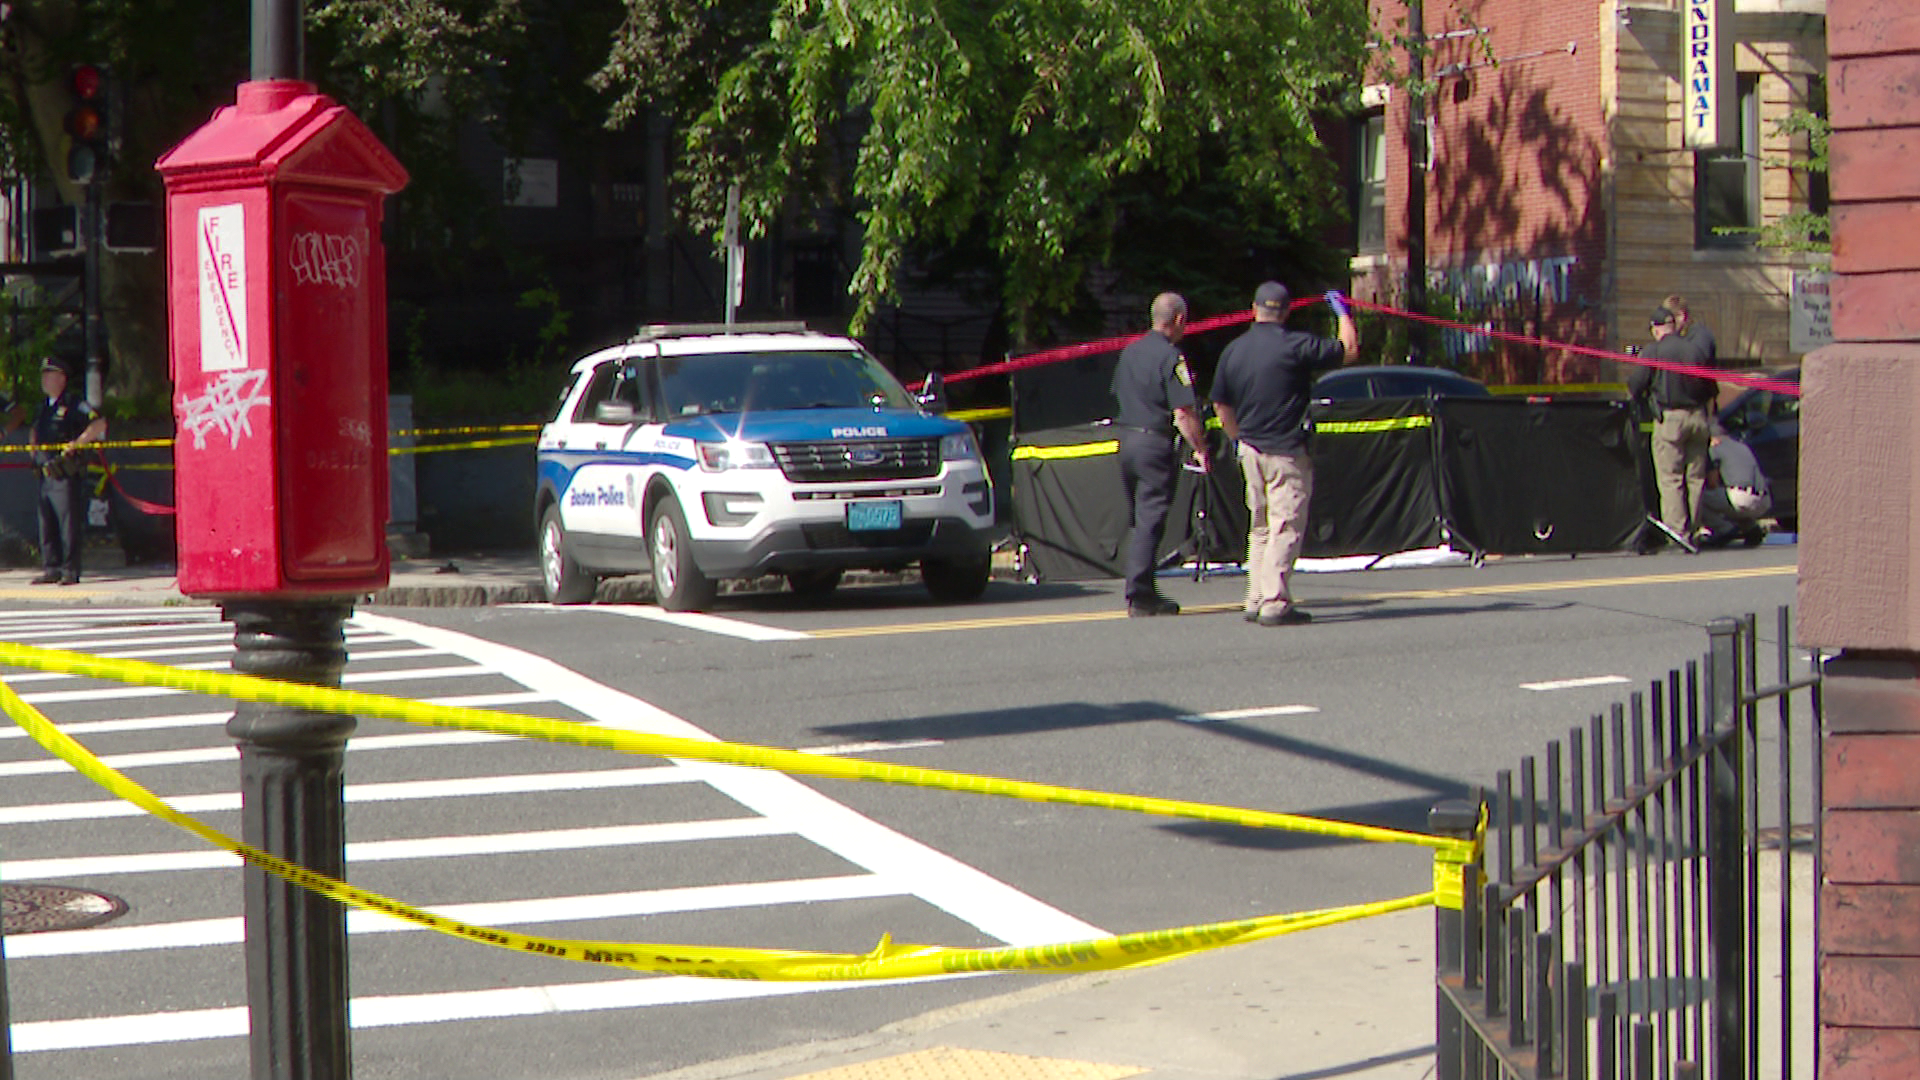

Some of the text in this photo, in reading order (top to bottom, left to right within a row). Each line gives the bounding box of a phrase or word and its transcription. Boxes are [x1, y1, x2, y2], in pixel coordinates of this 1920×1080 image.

[209, 217, 238, 290] FIRE
[205, 260, 236, 360] EMERGENCY
[832, 427, 887, 437] POLICE
[571, 484, 624, 506] Boston Police
